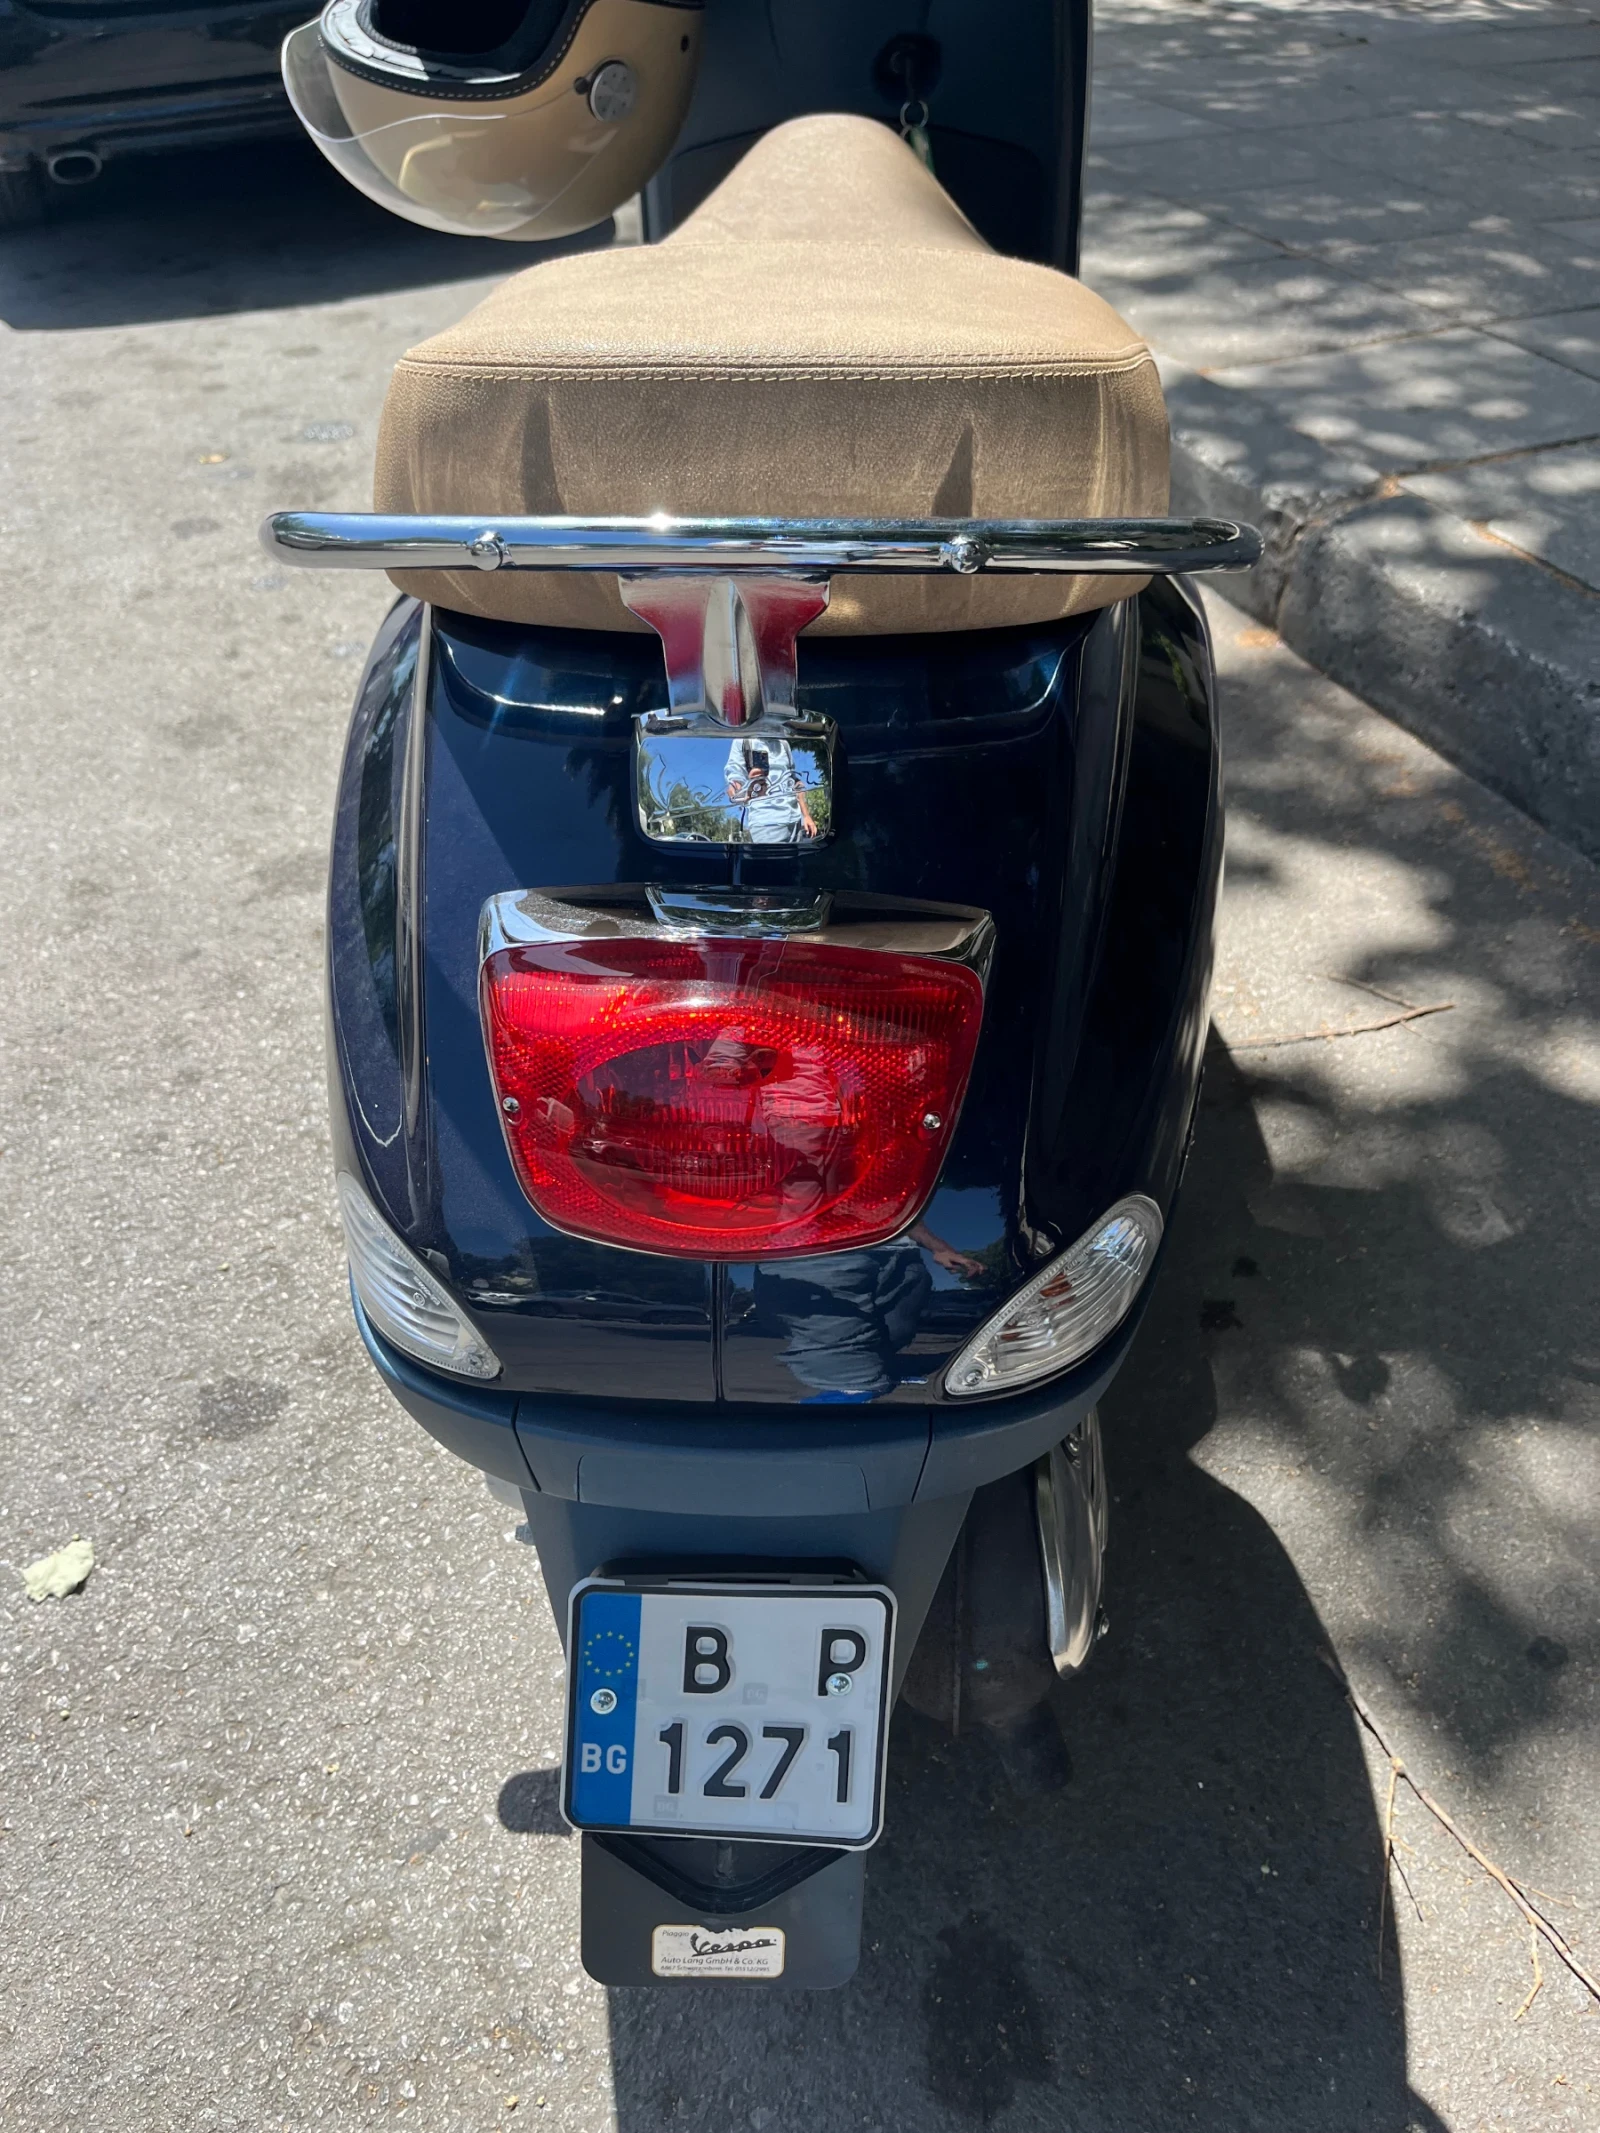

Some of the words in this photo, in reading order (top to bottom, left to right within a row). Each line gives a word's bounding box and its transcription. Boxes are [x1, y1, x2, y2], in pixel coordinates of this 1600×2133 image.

[683, 1626, 731, 1694] B
[818, 1628, 867, 1697] P
[580, 1743, 627, 1774] BG
[659, 1722, 851, 1803] 1271
[662, 1930, 689, 1938] Piaggio
[690, 1932, 776, 1957] Vespa
[682, 1957, 703, 1965] Lang
[705, 1957, 733, 1965] GmbH
[734, 1957, 741, 1965] &
